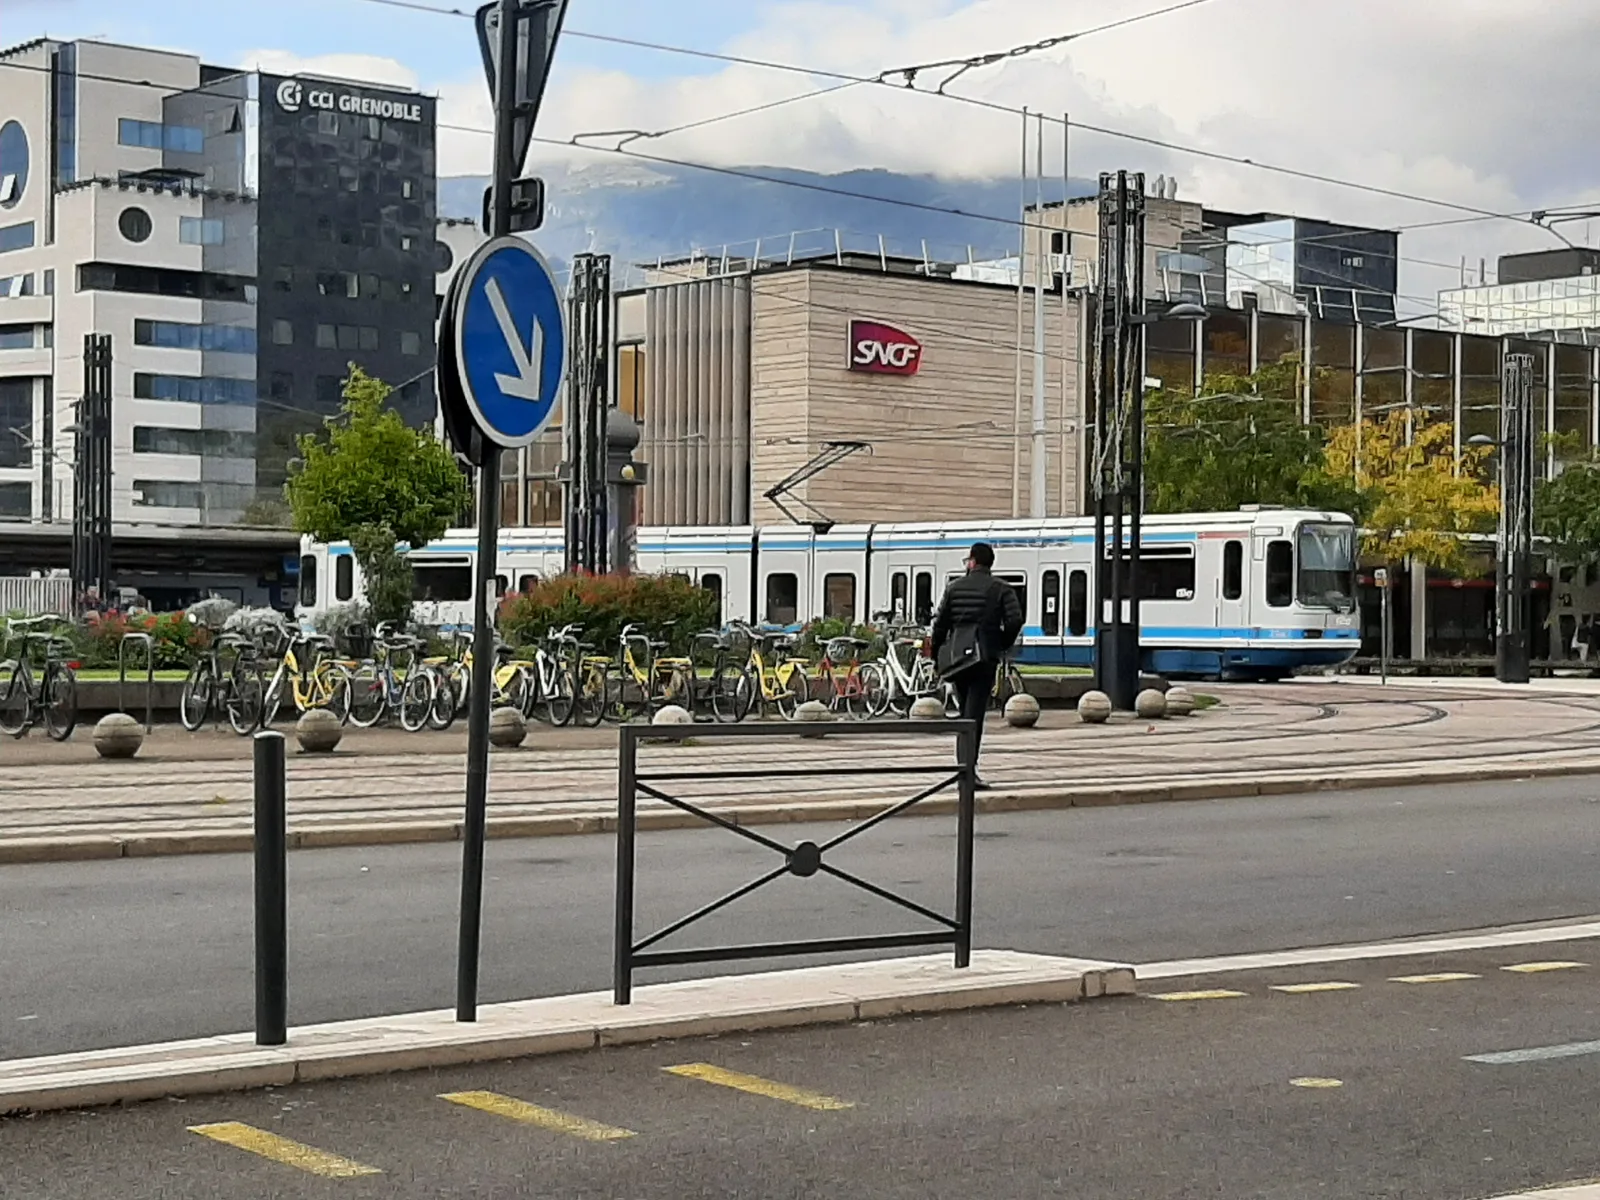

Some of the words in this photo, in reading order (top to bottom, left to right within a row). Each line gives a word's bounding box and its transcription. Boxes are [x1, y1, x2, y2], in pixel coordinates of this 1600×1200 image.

[308, 91, 334, 109] CCI
[338, 94, 421, 121] GRENOBLE
[853, 340, 919, 366] SNCF
